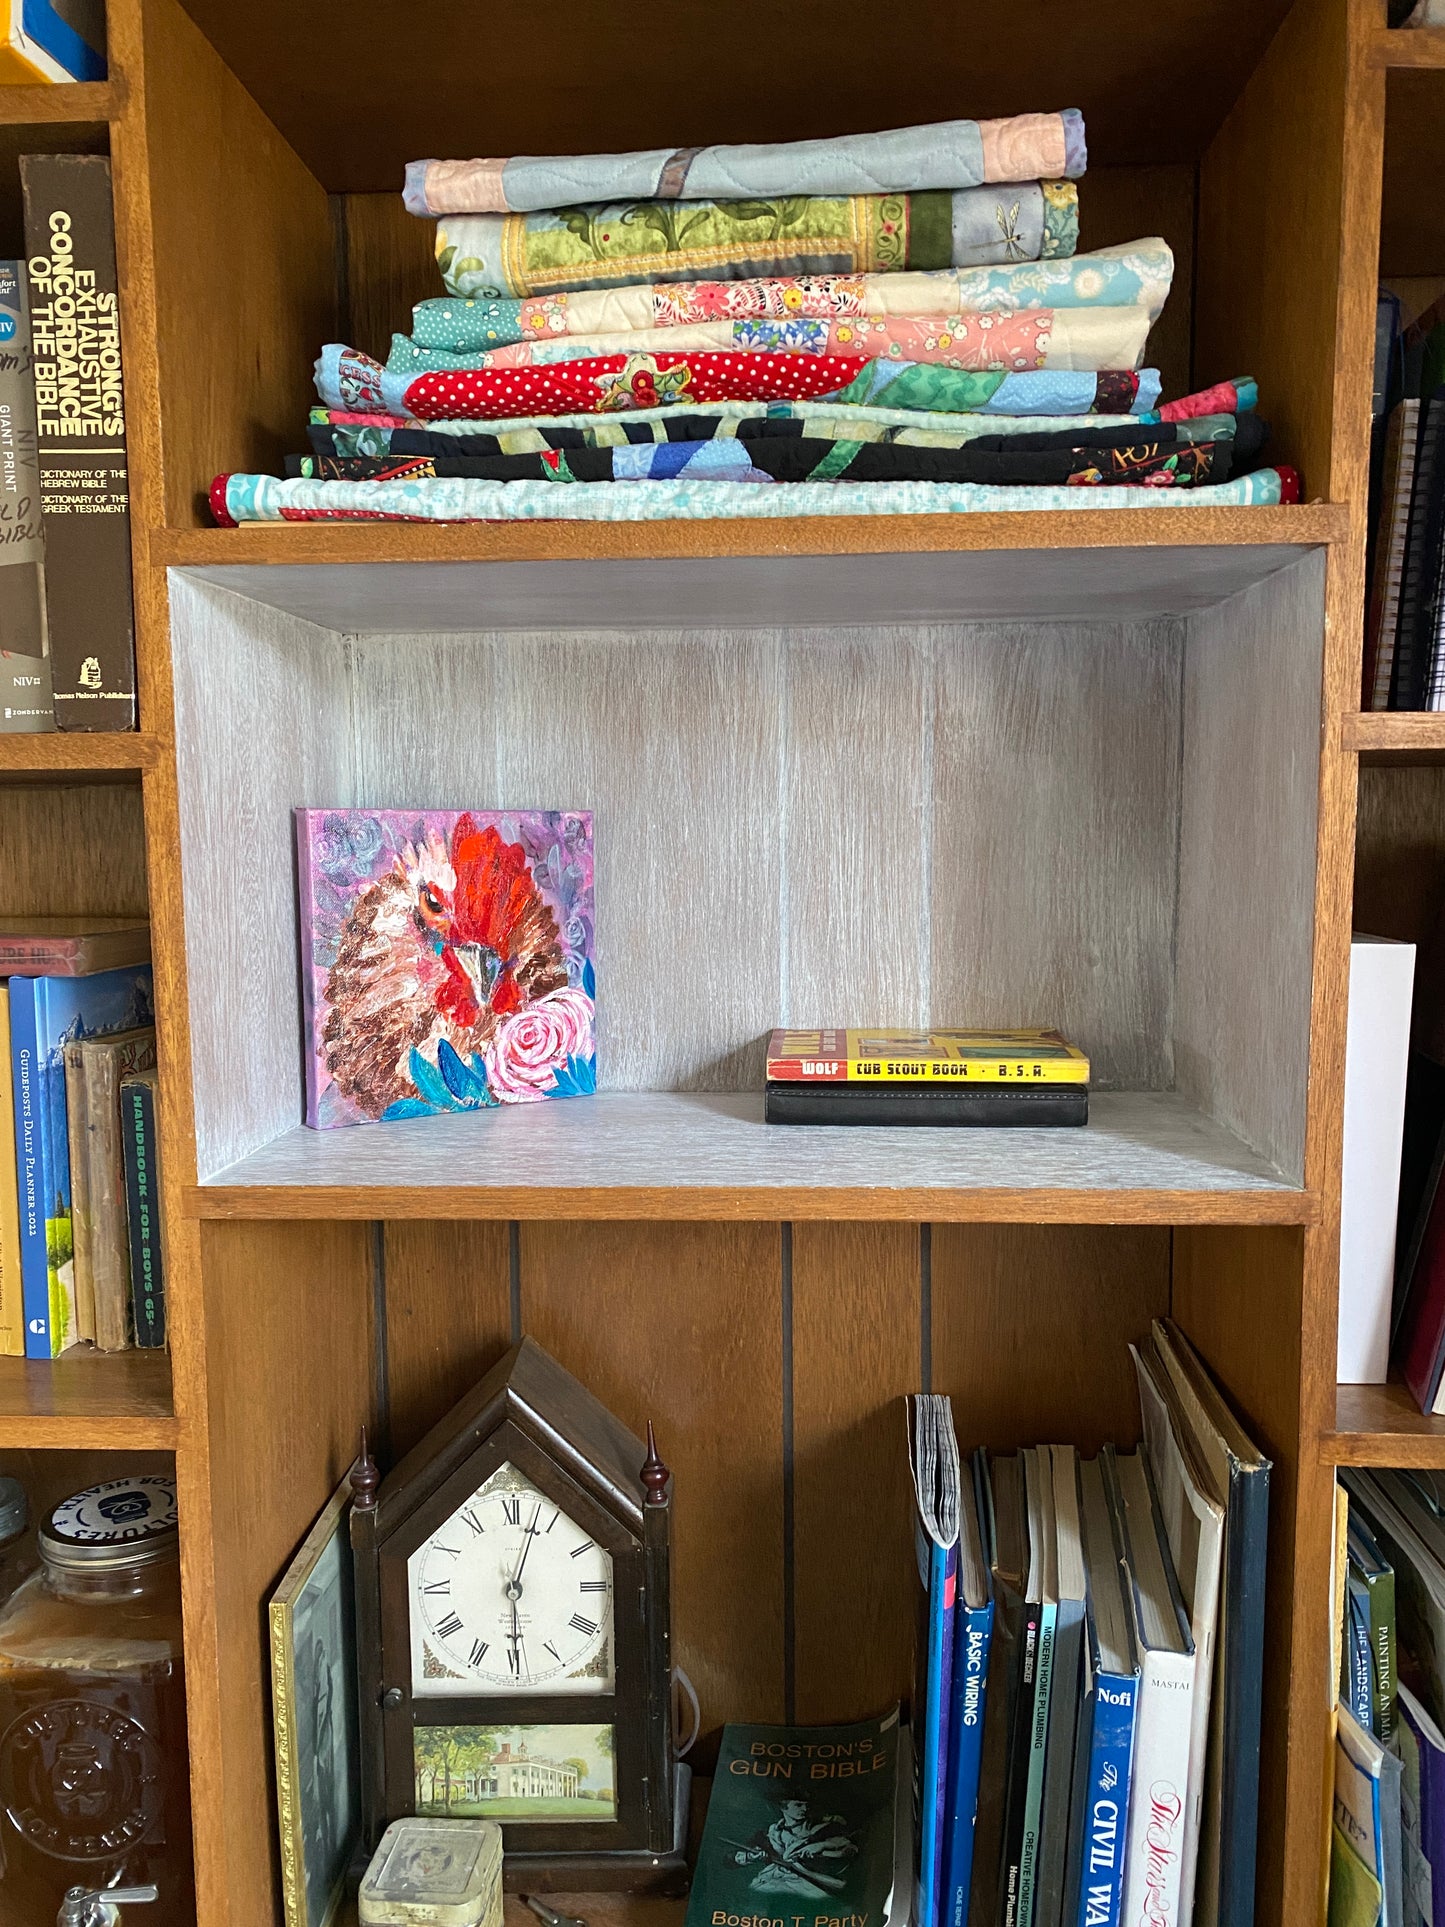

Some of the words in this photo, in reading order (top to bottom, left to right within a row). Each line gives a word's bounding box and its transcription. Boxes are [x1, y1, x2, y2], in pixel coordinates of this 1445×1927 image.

[28, 256, 53, 295] OF
[31, 302, 56, 356] THE
[48, 210, 84, 437] CONCORDANCE
[73, 269, 105, 437] EXHAUSTIVE
[95, 293, 125, 437] STRONG'S
[34, 362, 60, 437] BIBLE
[17, 430, 36, 469] NIV
[3, 450, 17, 494] PRINT
[40, 470, 92, 478] DICTIONARY
[94, 470, 108, 478] OF
[110, 470, 127, 478] THE
[40, 480, 80, 488] HEBREW
[82, 480, 108, 488] BIBLE
[41, 494, 93, 504] DICTIONARY
[95, 494, 108, 504] OF
[110, 494, 128, 504] THE
[42, 504, 72, 513] GREEK
[74, 504, 126, 513] TESTAMENT
[13, 676, 34, 686] NIV
[19, 1049, 33, 1116] GUIDEPOSTS
[802, 1062, 839, 1076] WOLF
[856, 1064, 880, 1075] CUB
[886, 1064, 927, 1075] SCOUT
[932, 1064, 968, 1076] BOOK
[23, 1120, 35, 1154] DAILY
[132, 1094, 148, 1198] HANDBOOK
[25, 1157, 37, 1209] PLANNER
[27, 1211, 38, 1236] 2022
[140, 1204, 152, 1240] FOR
[142, 1246, 154, 1292] BOYS
[58, 1479, 130, 1511] HEALTH
[74, 1508, 178, 1540] ULTURES
[580, 1580, 607, 1593] III
[968, 1631, 984, 1672] BASIC
[1038, 1625, 1052, 1668] MODERN
[1355, 1624, 1368, 1647] THE
[1378, 1625, 1391, 1690] PAINTING
[962, 1674, 982, 1726] WIRING
[1037, 1669, 1050, 1698] HOME
[1097, 1688, 1132, 1707] Nofi
[1150, 1678, 1190, 1691] MASTAI
[1033, 1700, 1048, 1750] PLUMBING
[729, 1759, 792, 1779] GUN
[810, 1750, 888, 1780] BIBLE
[750, 1738, 873, 1758] BOSTON'S
[1098, 1761, 1118, 1792] The
[1022, 1830, 1035, 1876] CREATIVE
[1089, 1800, 1118, 1874] CIVIL
[956, 1886, 964, 1904] HOME
[1008, 1865, 1018, 1893] Home
[712, 1910, 784, 1927] Boston
[814, 1912, 869, 1927] Party
[1085, 1883, 1112, 1927] WA
